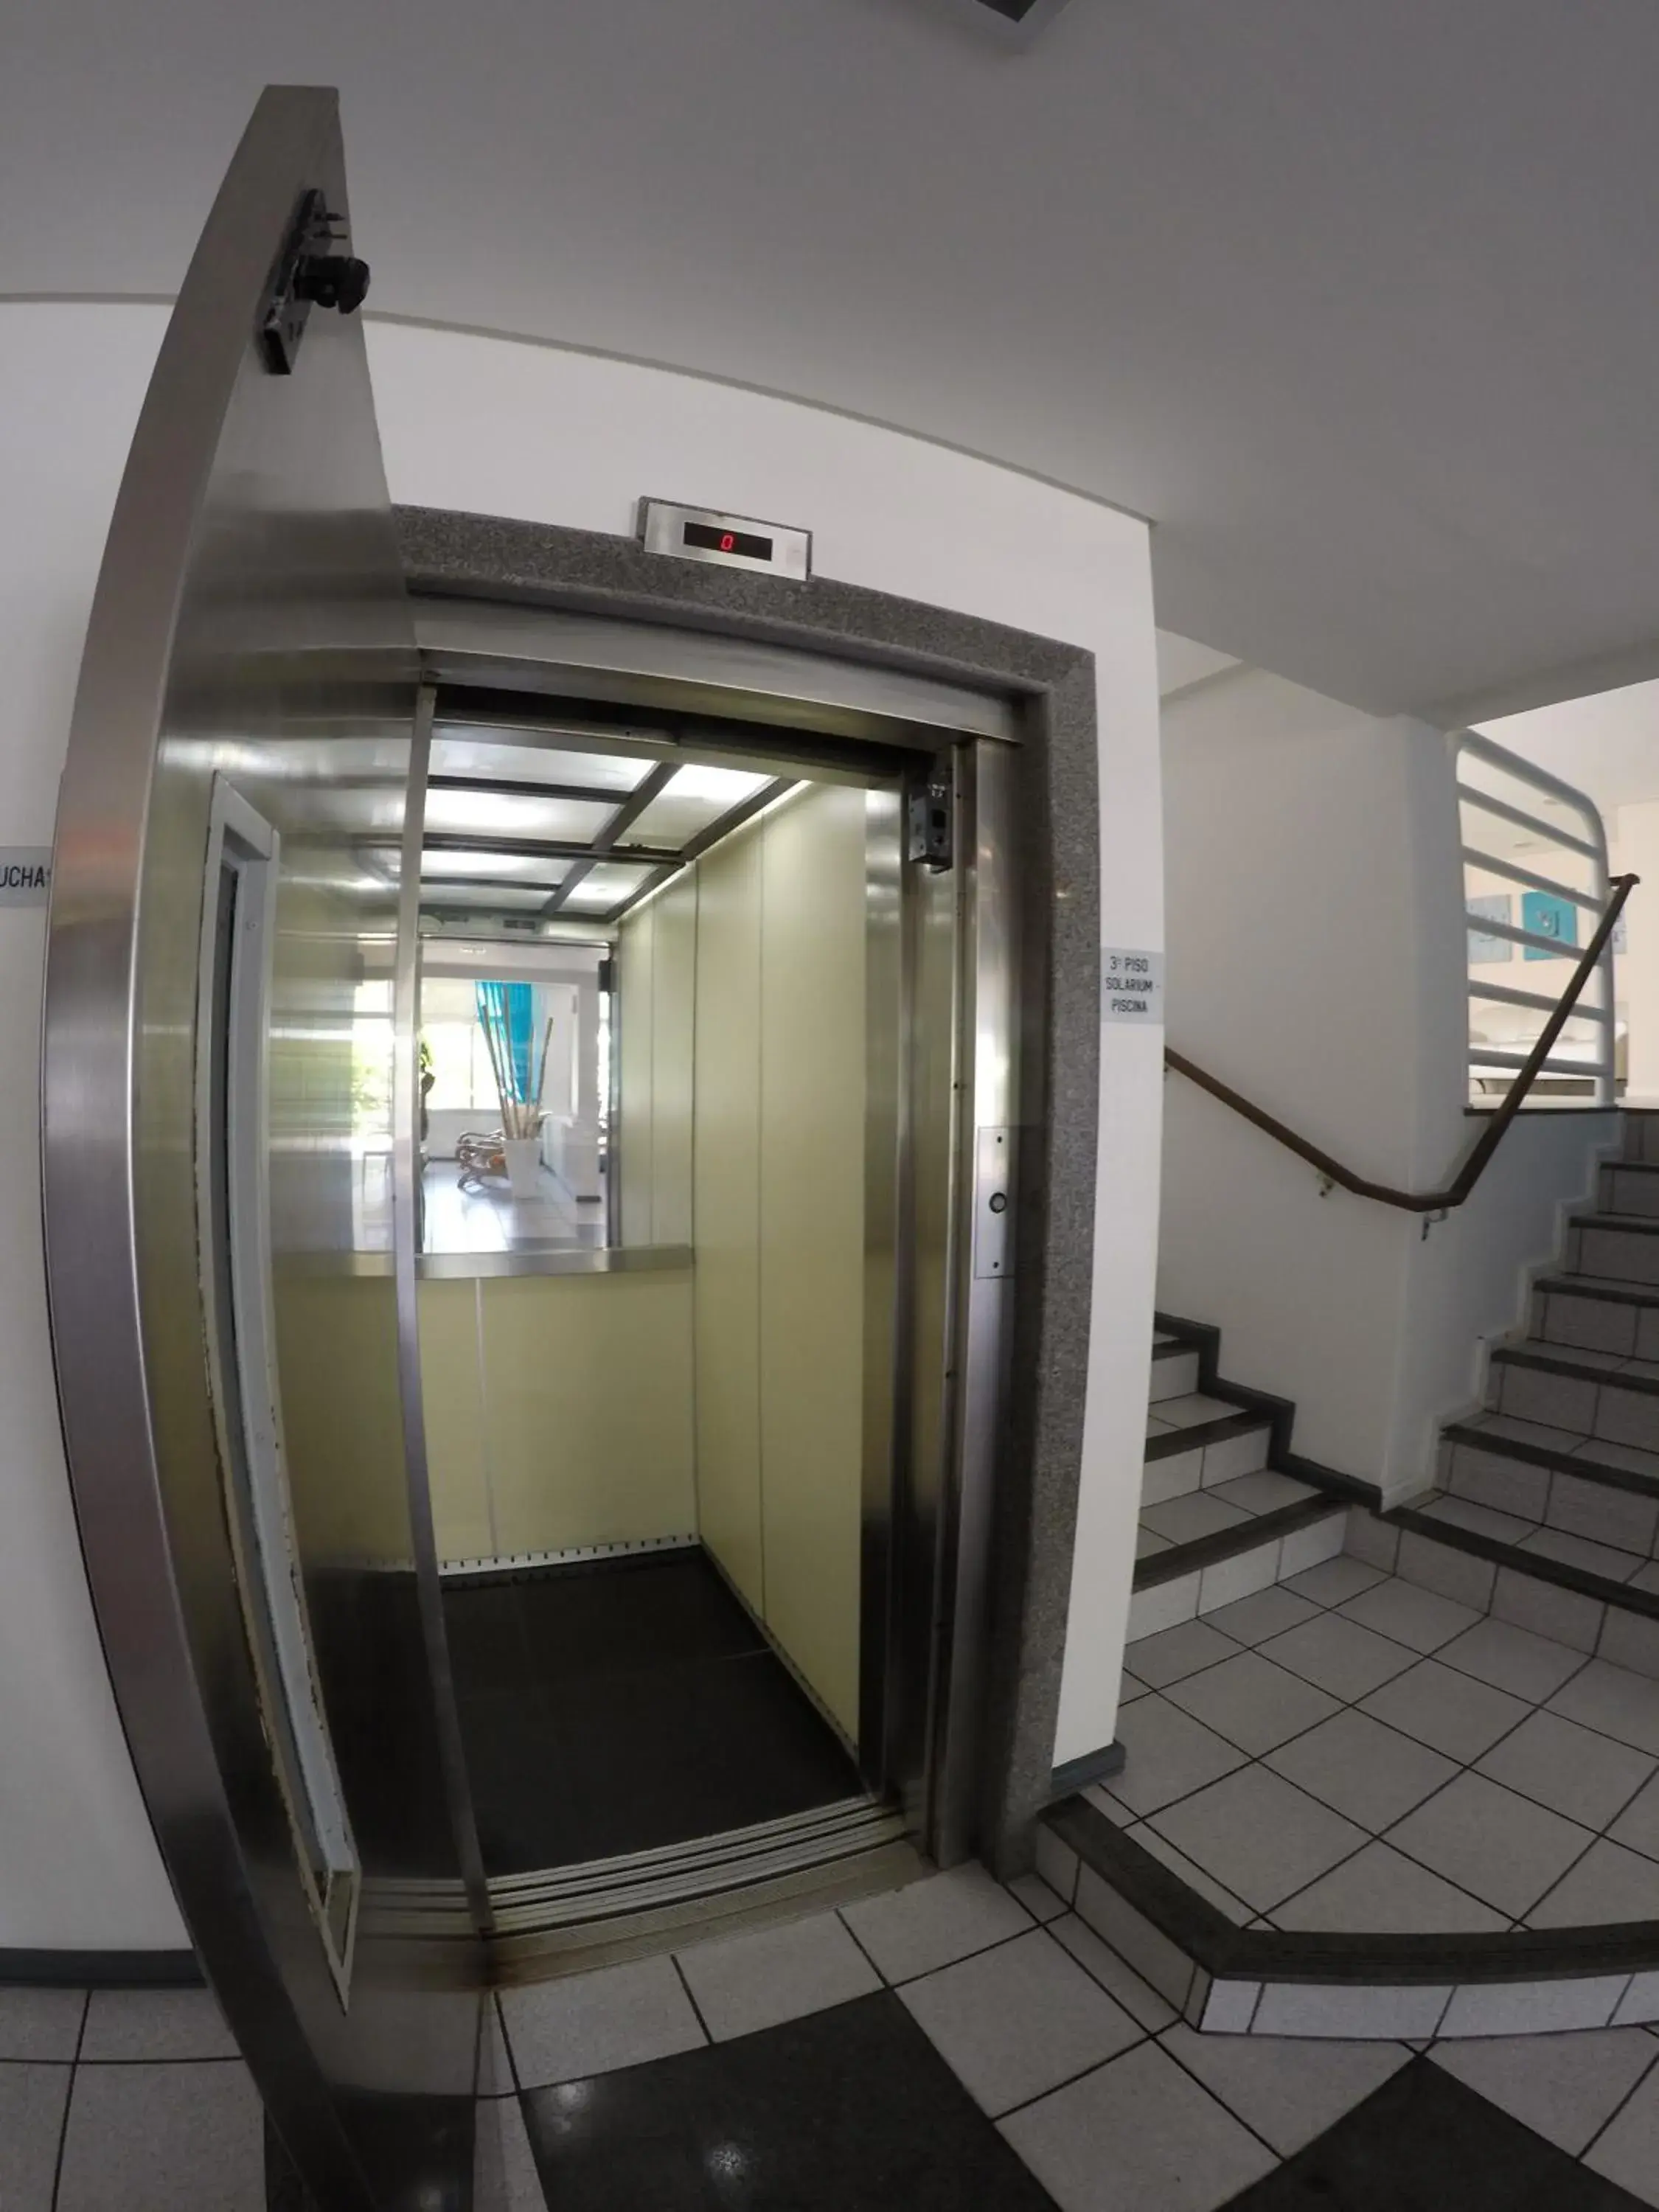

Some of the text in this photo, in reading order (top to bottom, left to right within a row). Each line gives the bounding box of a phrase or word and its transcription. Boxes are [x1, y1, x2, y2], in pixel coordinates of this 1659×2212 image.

[720, 534, 734, 550] 0
[1124, 956, 1149, 973] PISO
[1105, 976, 1153, 992] SOLARIUM
[1111, 998, 1148, 1013] PISCINA
